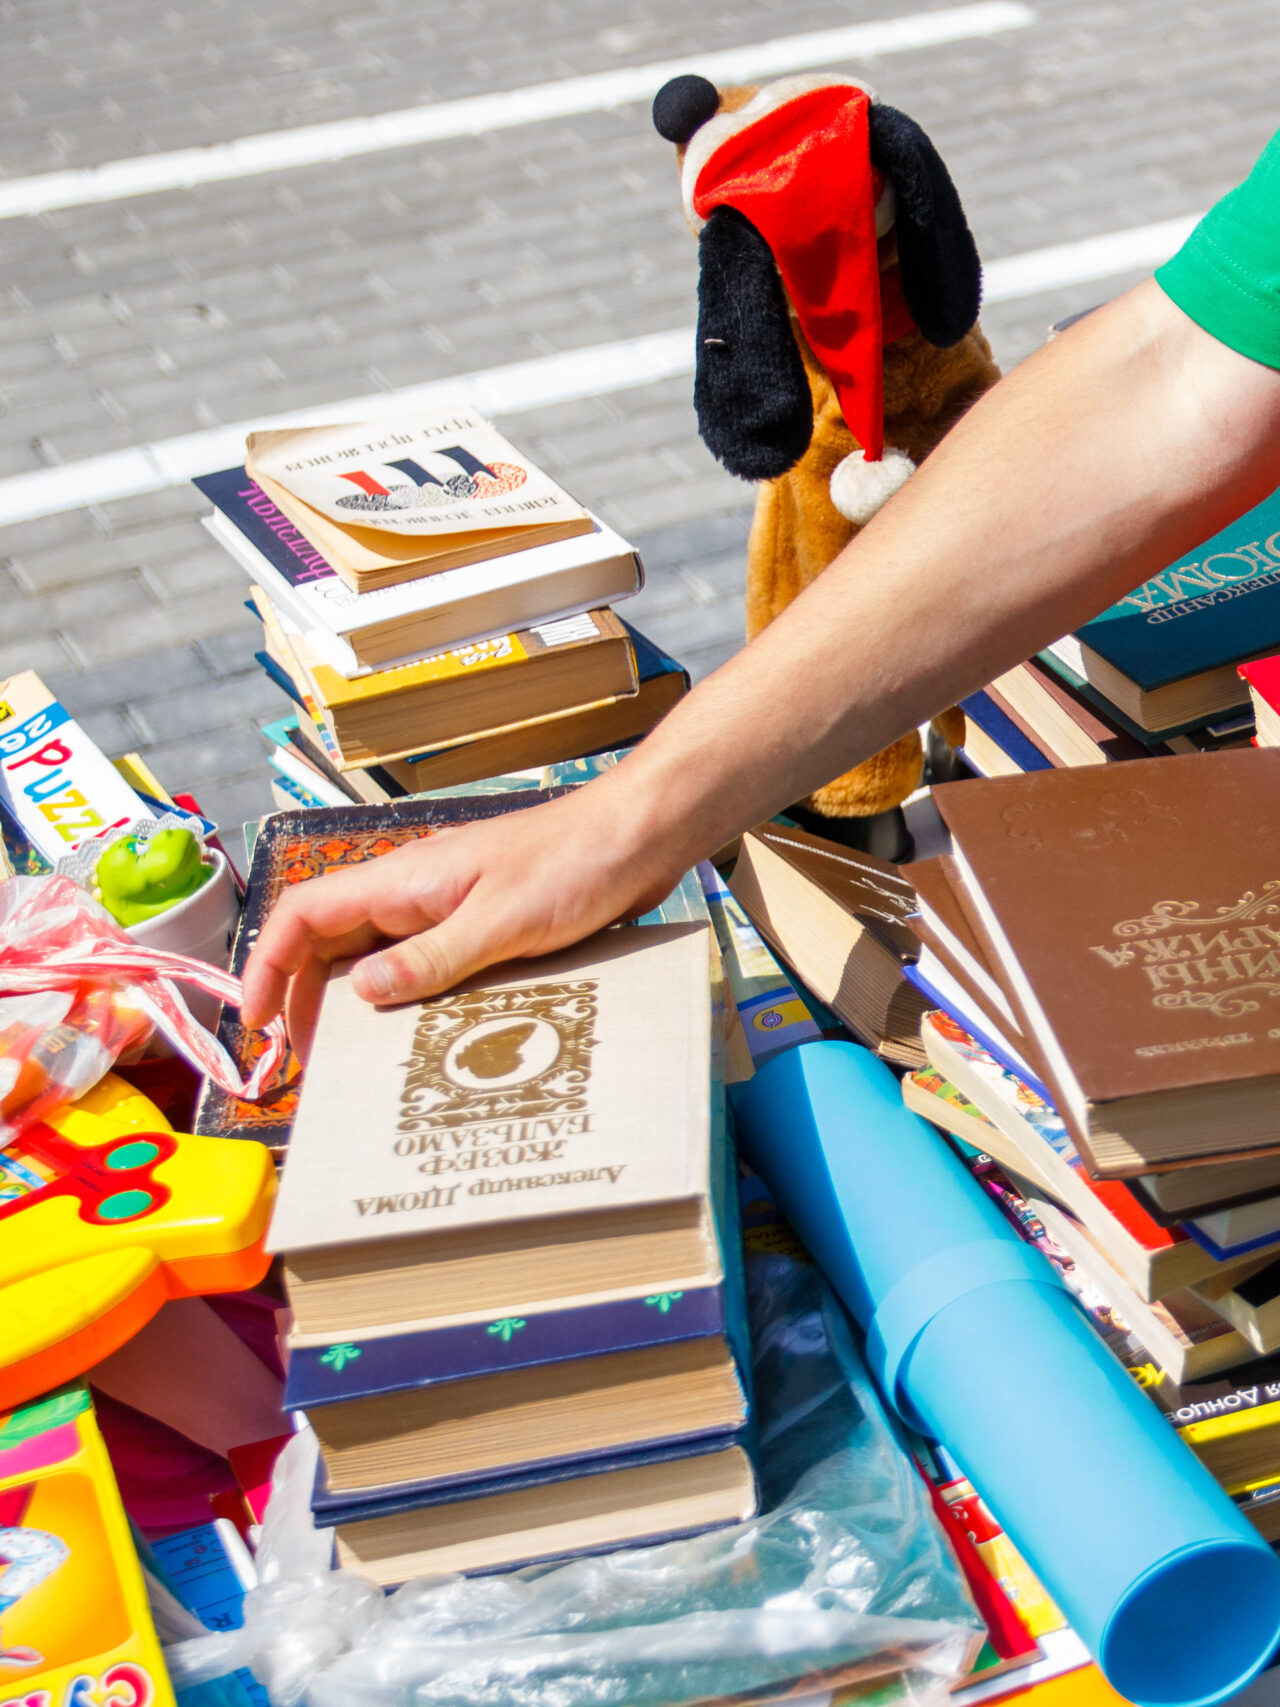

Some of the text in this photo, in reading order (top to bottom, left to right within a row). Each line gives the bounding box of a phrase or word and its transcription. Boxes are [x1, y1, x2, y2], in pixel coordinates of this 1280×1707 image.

[393, 1113, 597, 1156] БАЛЬЗАМО
[418, 1139, 568, 1175] ЖОЗЕФ
[352, 1164, 629, 1216] Александр ДЮМА
